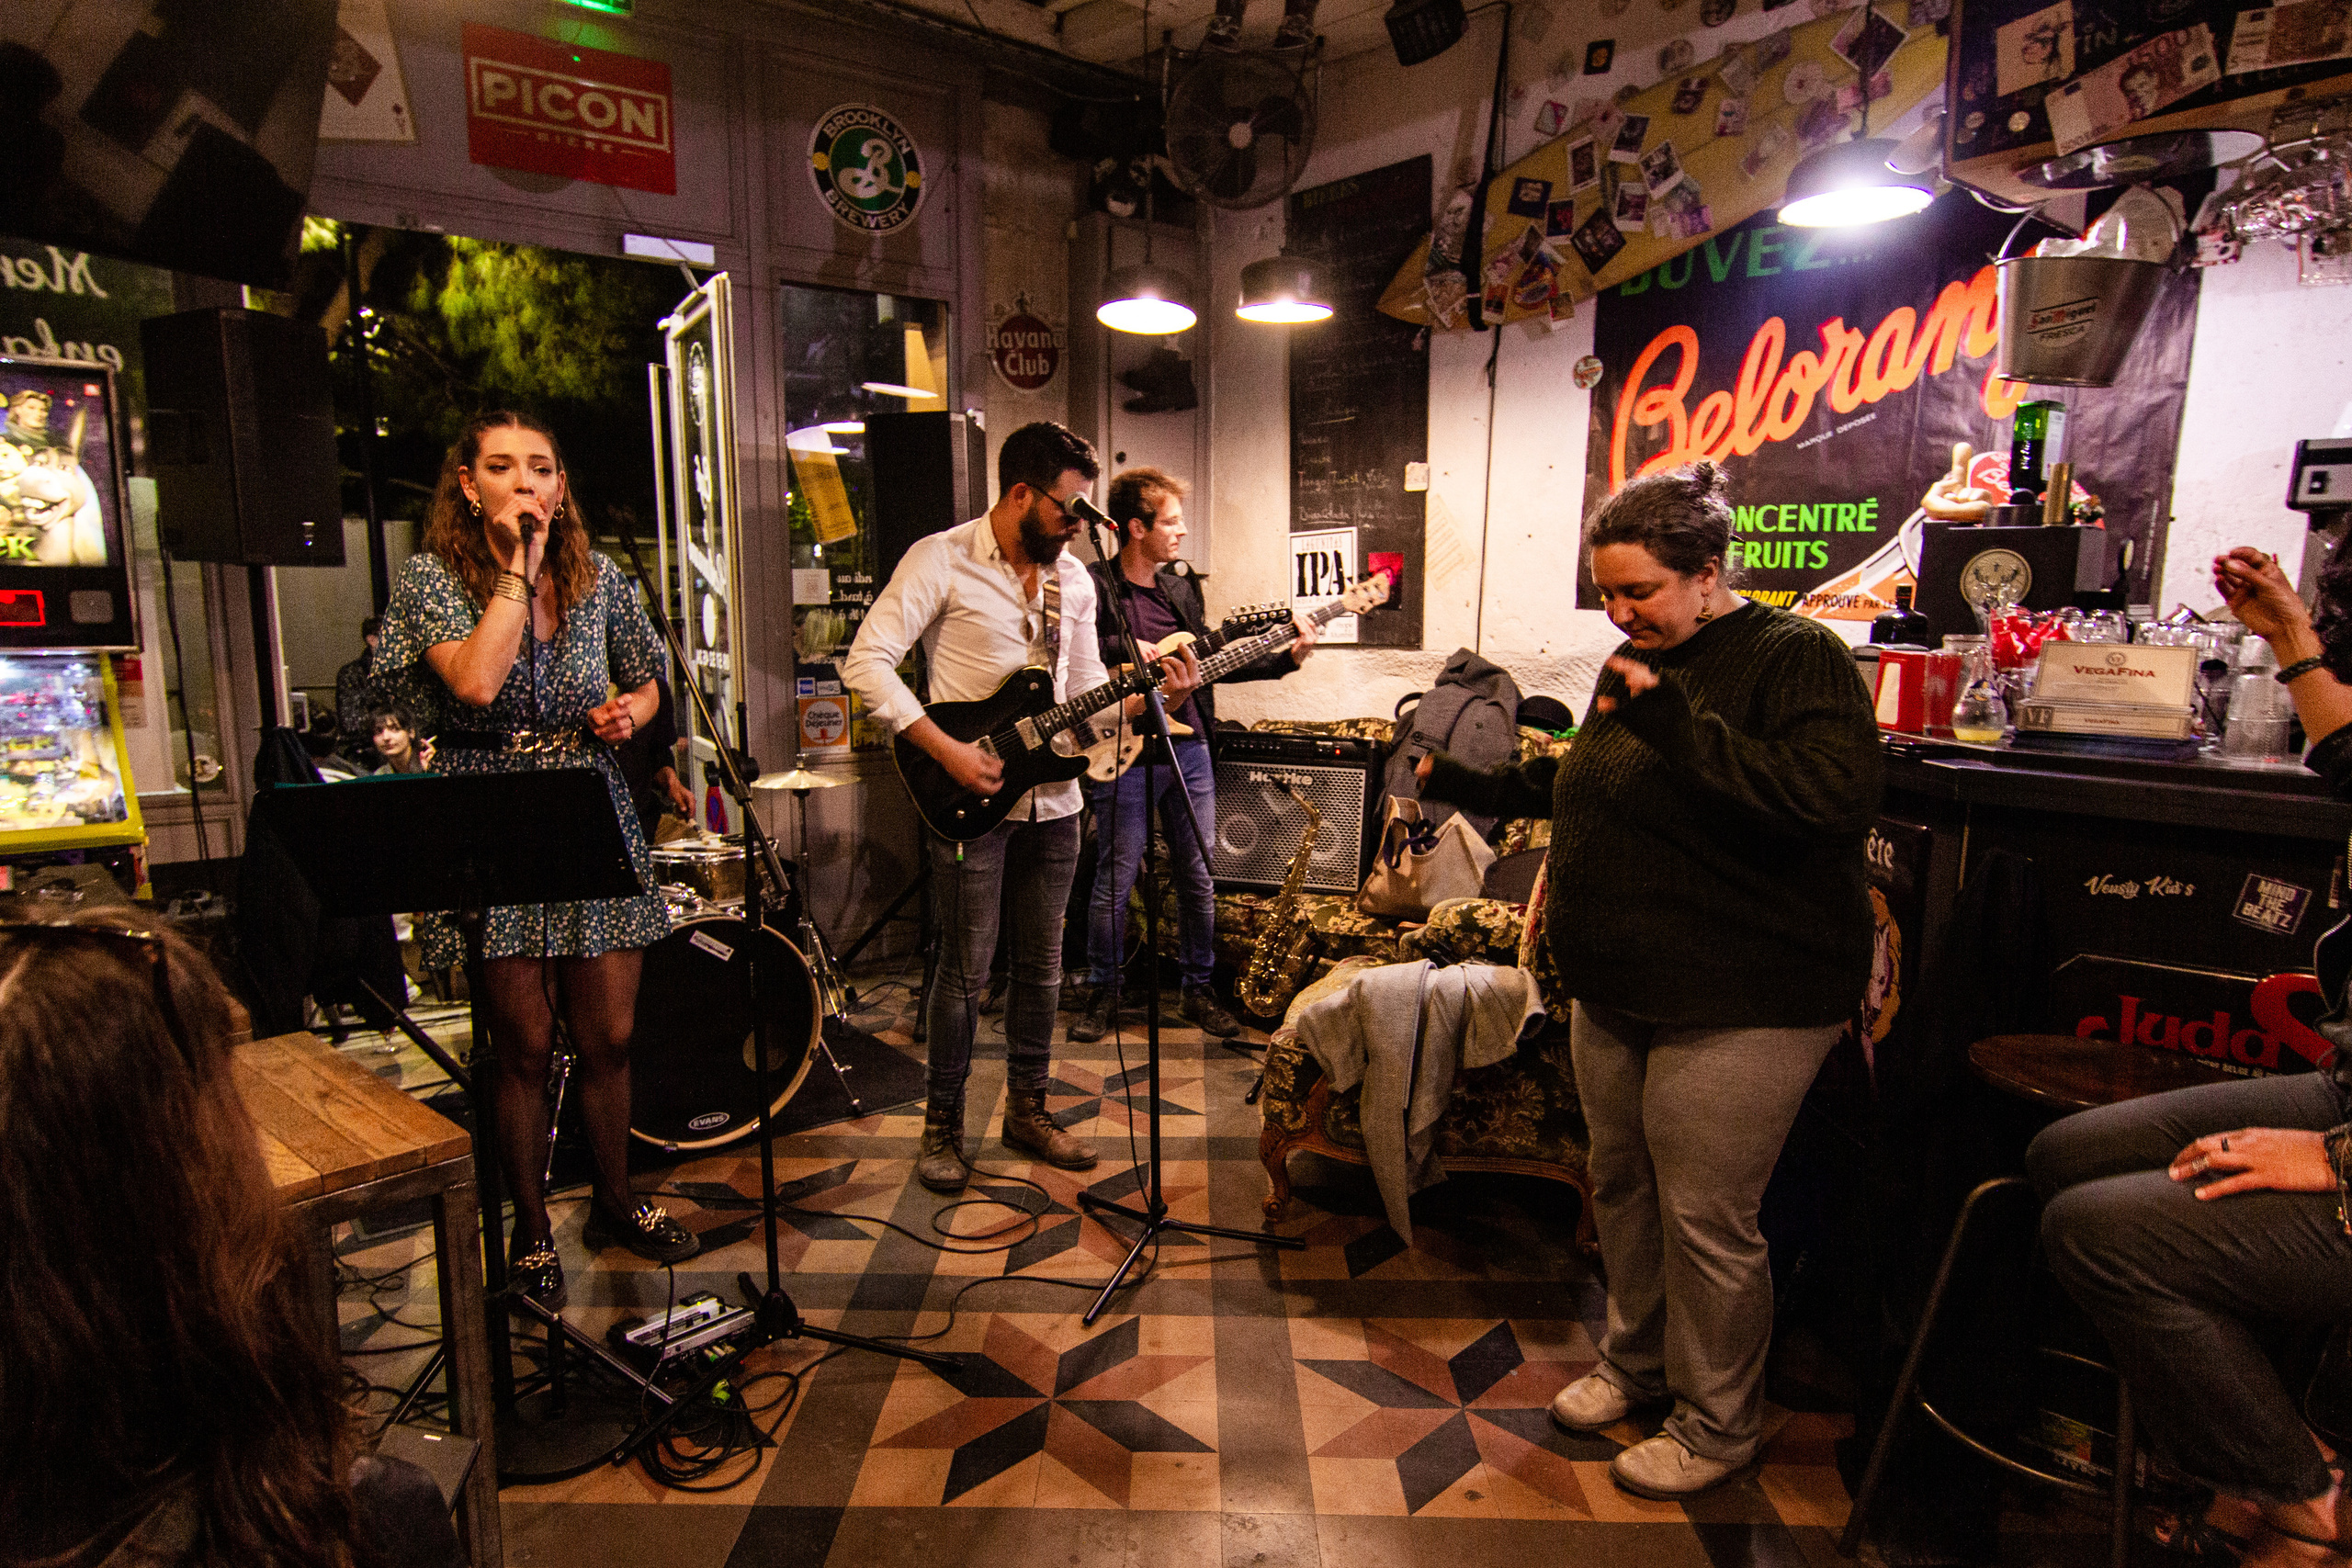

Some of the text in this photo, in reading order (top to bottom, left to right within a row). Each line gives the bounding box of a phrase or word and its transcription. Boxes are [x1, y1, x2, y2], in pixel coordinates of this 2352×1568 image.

[482, 71, 656, 138] PICON
[822, 110, 911, 154] BROOKLYN
[825, 188, 910, 228] BREWERY
[985, 321, 1066, 348] Havana
[1004, 352, 1050, 377] Club
[1727, 539, 1829, 570] FRUITS
[1295, 550, 1346, 597] IPA
[1863, 599, 1879, 609] PAR
[2257, 879, 2298, 902] MIND
[2258, 893, 2288, 913] THE
[2242, 901, 2294, 929] BEATZ
[693, 1114, 724, 1128] EVANS
